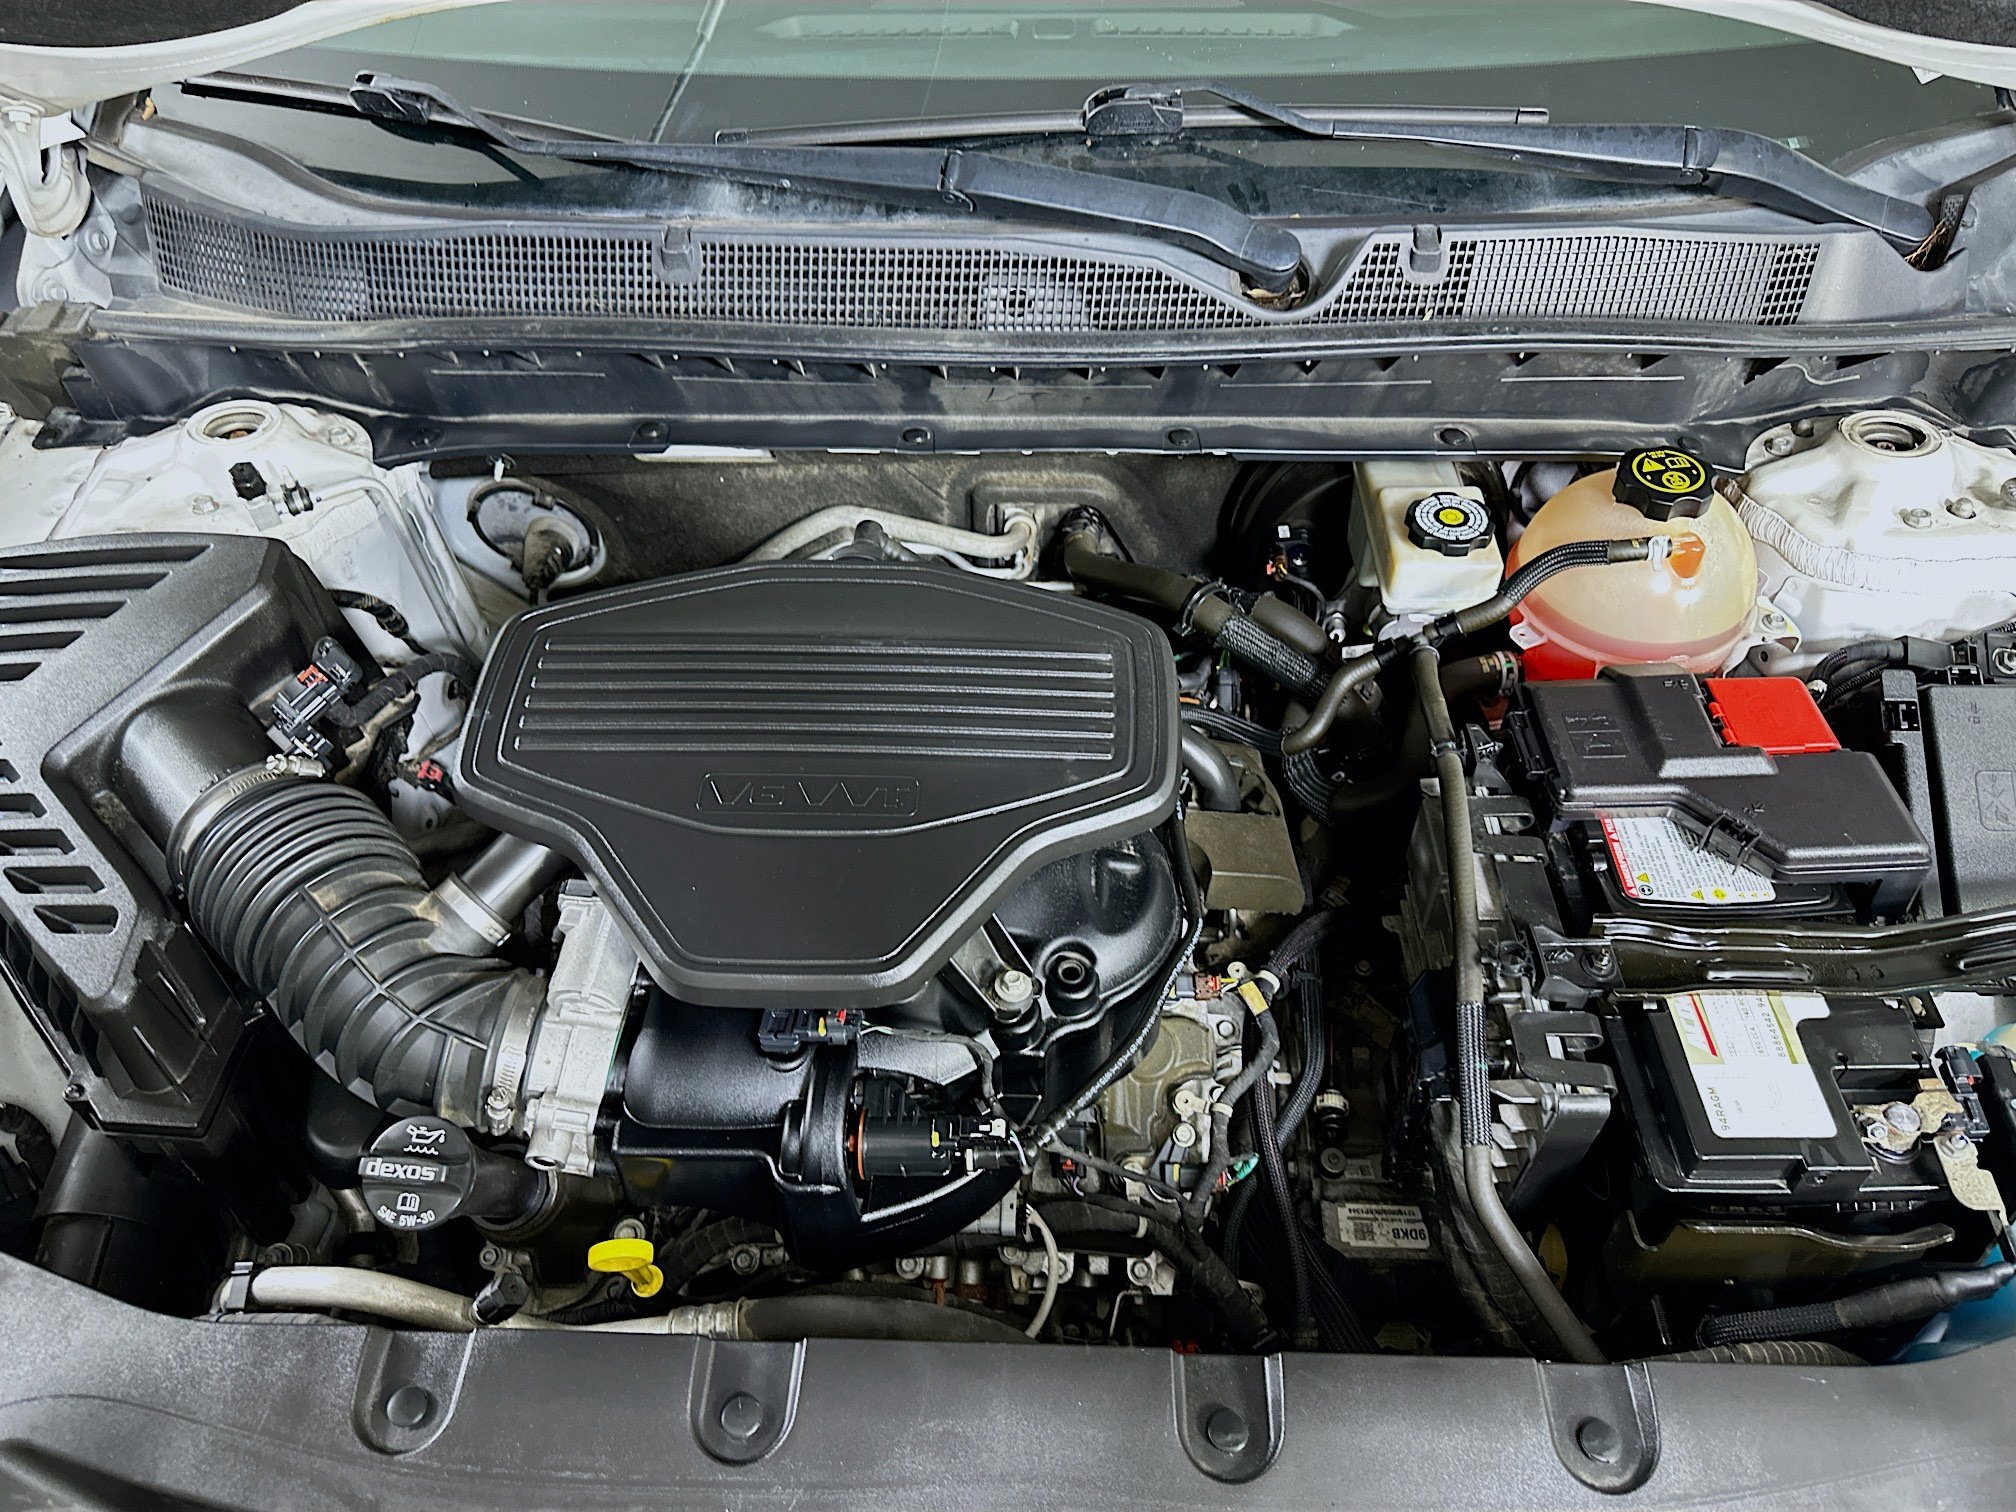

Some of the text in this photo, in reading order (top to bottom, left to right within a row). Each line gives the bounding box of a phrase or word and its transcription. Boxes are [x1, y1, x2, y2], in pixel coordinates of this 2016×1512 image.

[1762, 1012, 1786, 1058] 88864542
[1706, 1086, 1731, 1131] 94RAGM
[365, 1158, 436, 1181] dexos
[377, 1205, 436, 1227] SAE 5W-30
